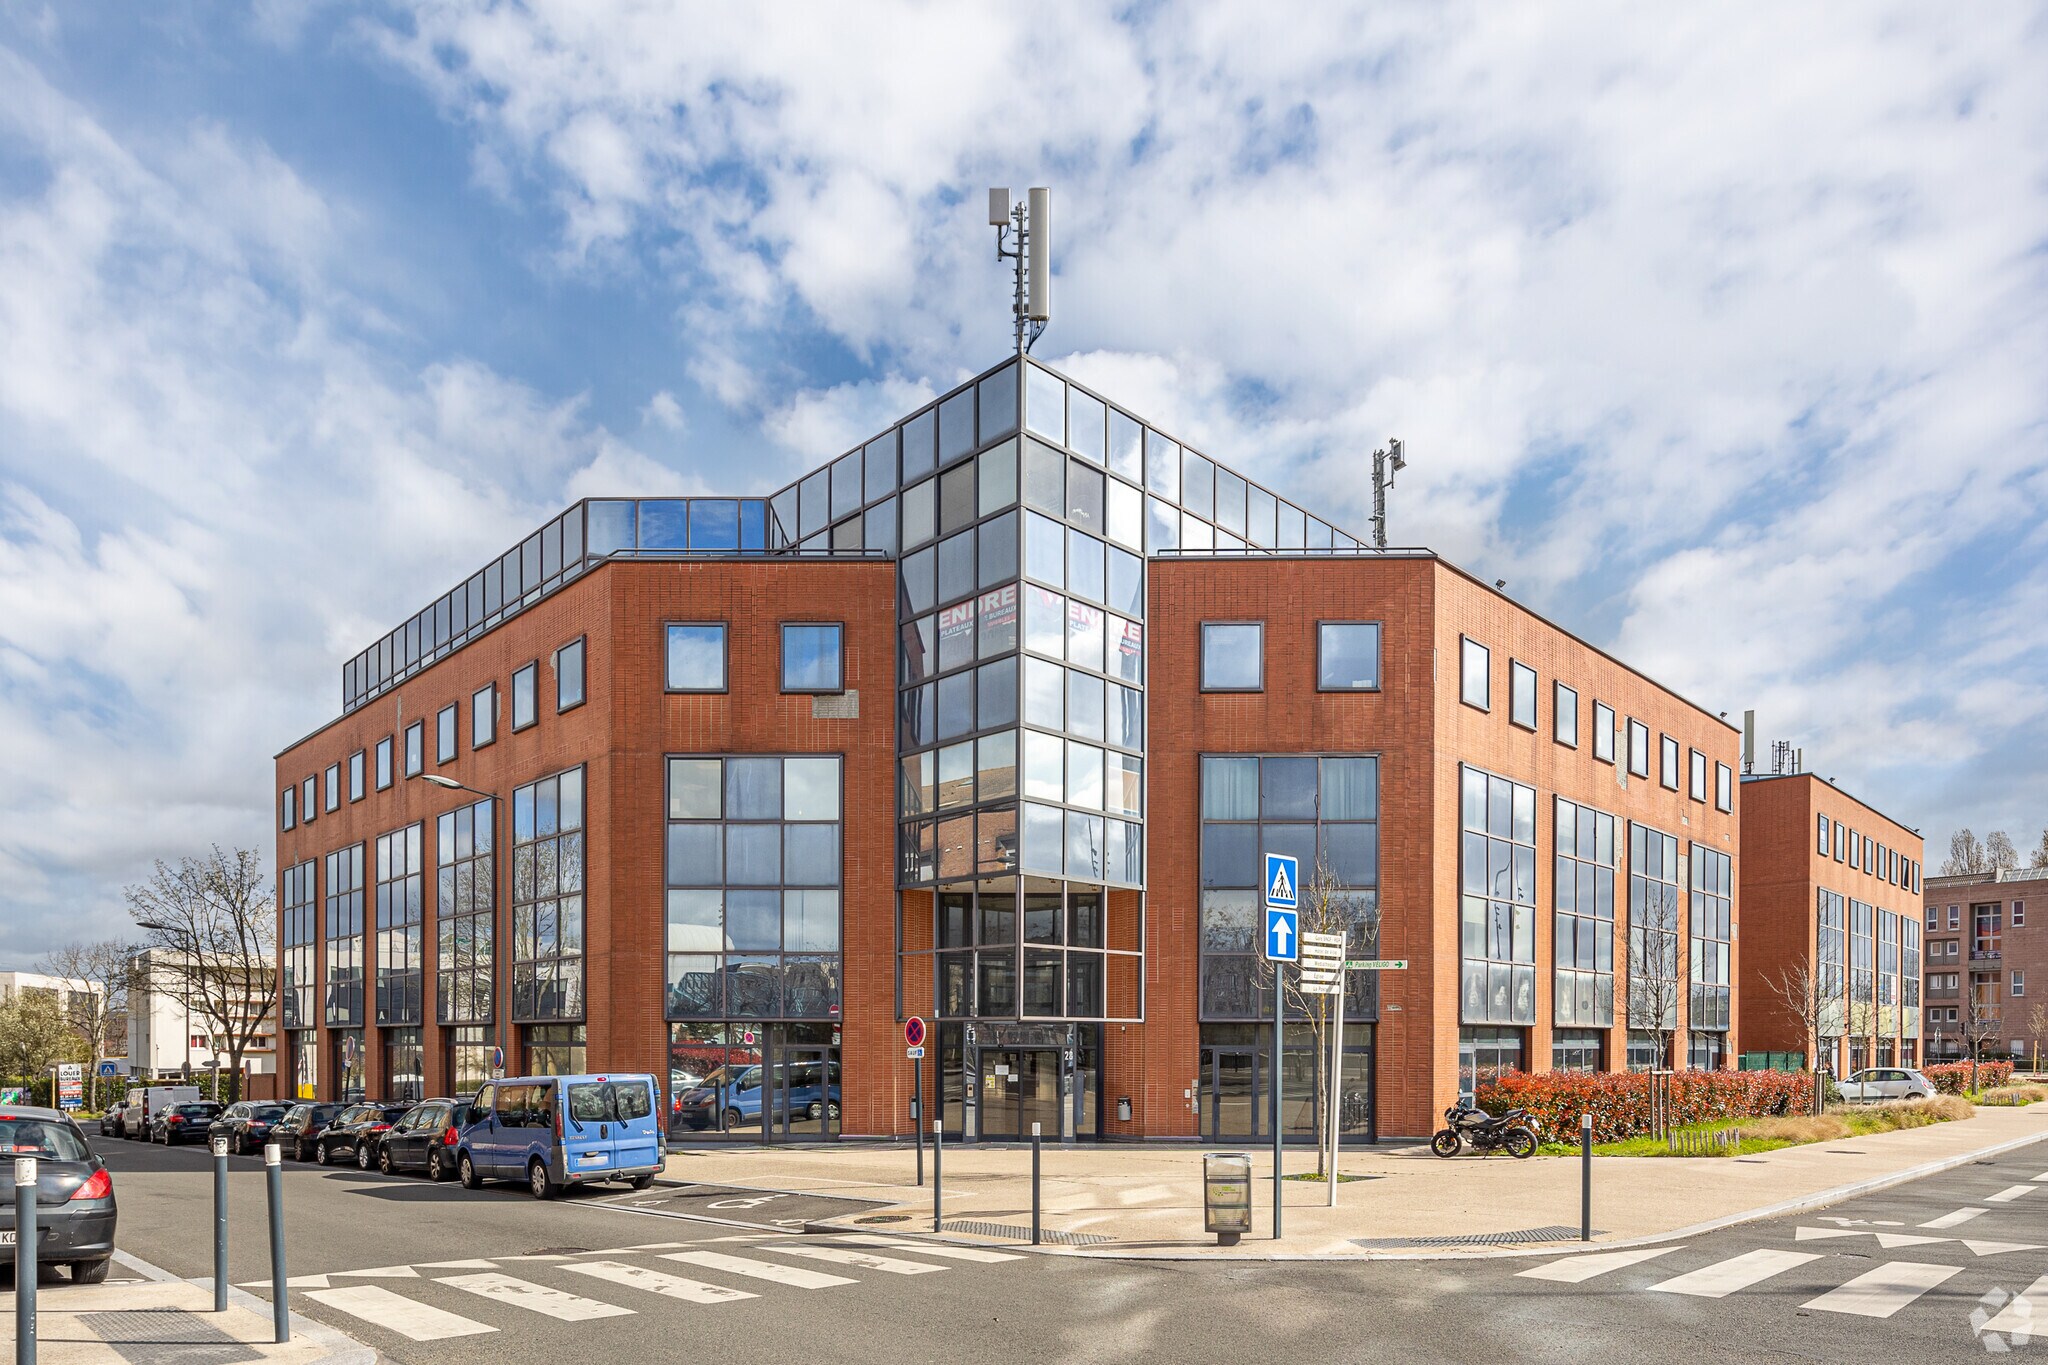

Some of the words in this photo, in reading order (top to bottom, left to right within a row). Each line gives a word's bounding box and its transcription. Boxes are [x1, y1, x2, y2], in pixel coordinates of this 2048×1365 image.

[941, 620, 974, 638] PLATEAUX
[988, 605, 1016, 620] BUREAUX
[1355, 961, 1372, 969] Parking
